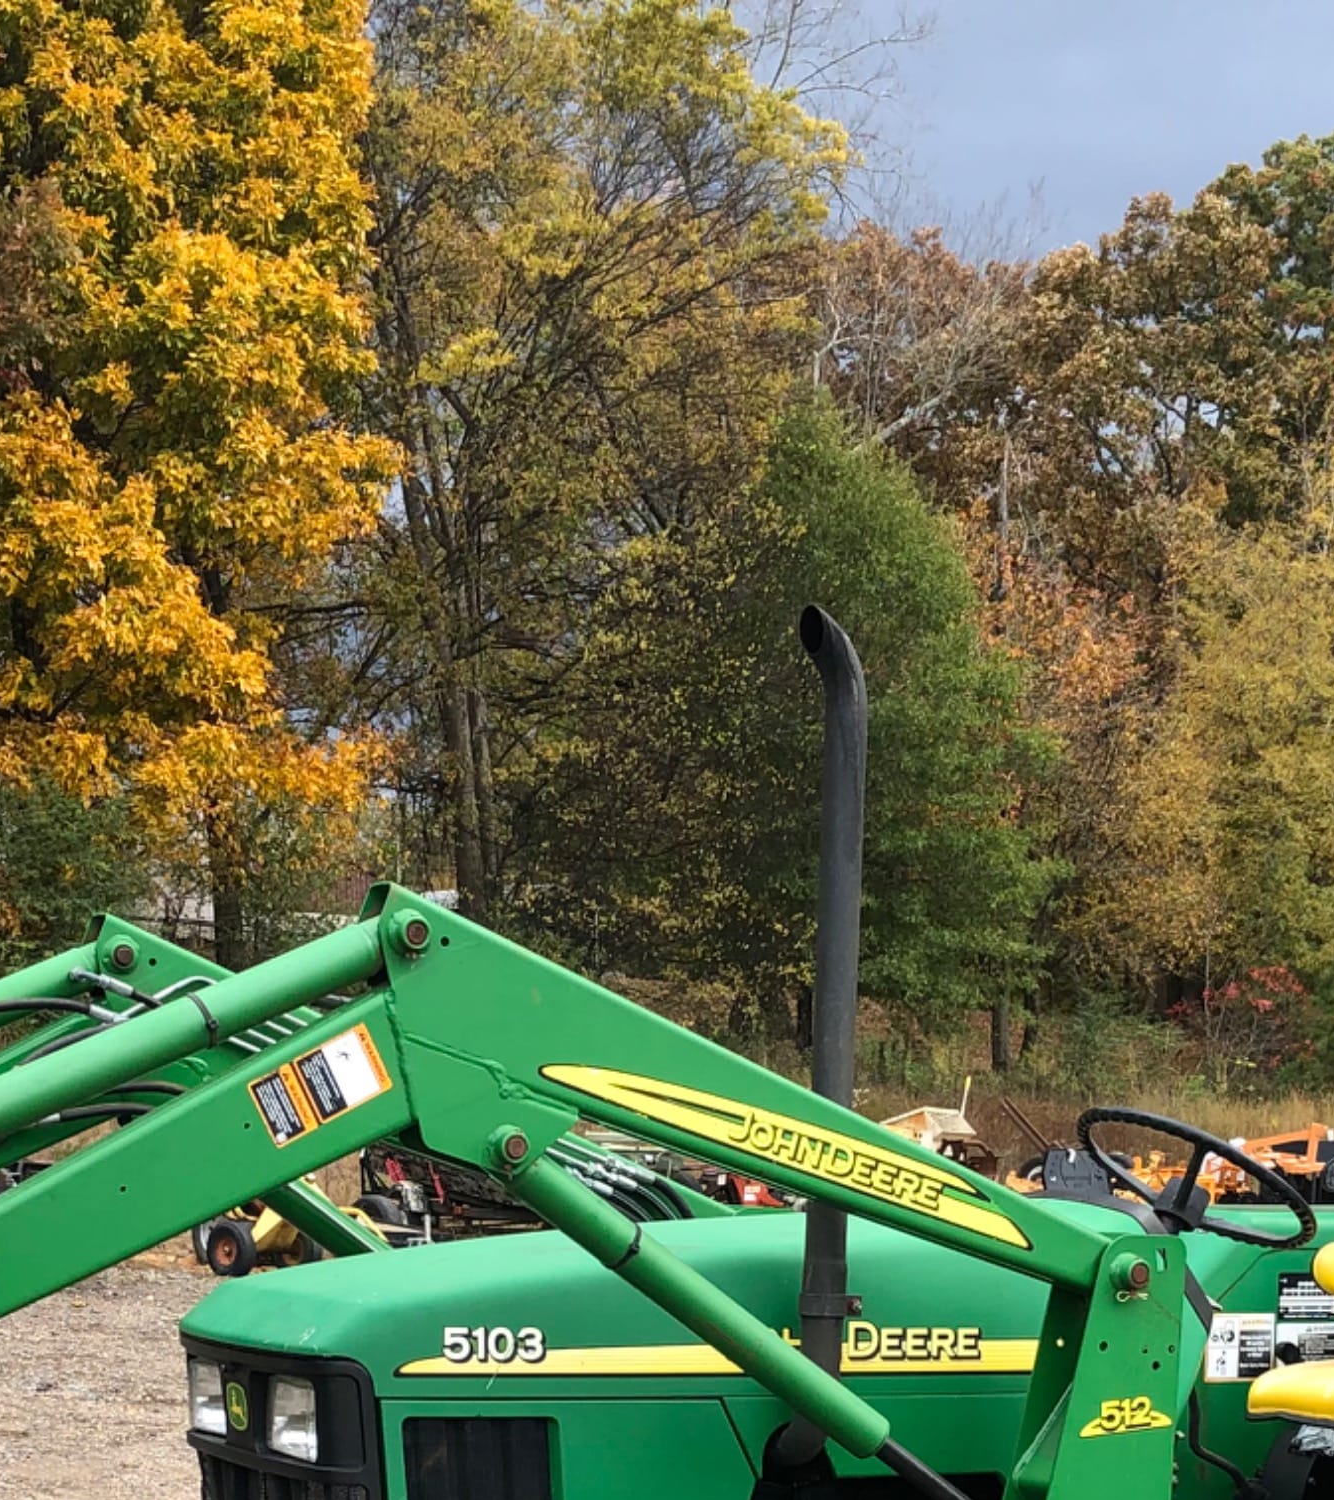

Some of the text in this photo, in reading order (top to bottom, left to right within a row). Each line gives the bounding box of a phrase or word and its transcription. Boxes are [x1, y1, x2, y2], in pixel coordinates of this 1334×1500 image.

[728, 1112, 944, 1211] JOHN DEERE
[442, 1326, 547, 1364] 5103
[847, 1320, 982, 1361] DEERE
[1100, 1396, 1152, 1431] 512
